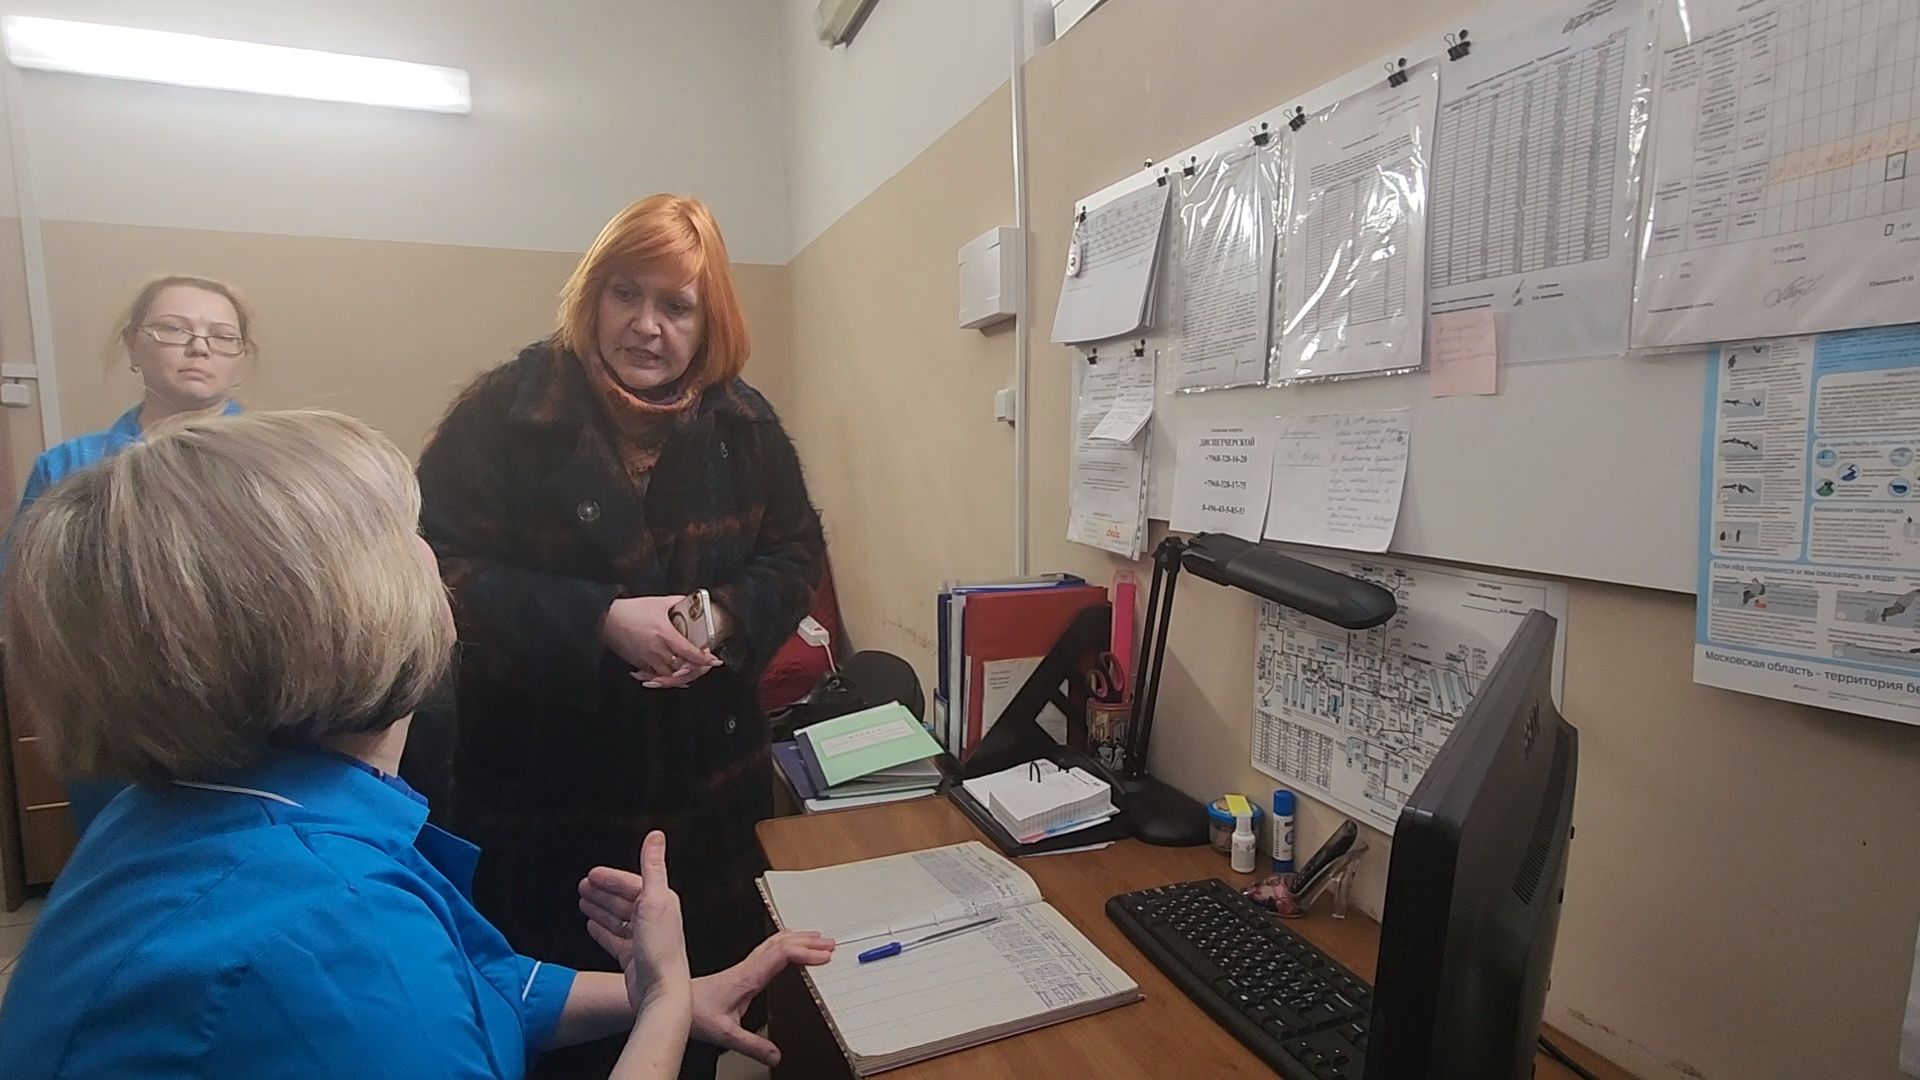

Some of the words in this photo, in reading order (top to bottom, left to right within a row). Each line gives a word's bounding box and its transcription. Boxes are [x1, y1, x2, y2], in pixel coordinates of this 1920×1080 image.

[1705, 651, 1766, 669] Московская
[1767, 661, 1814, 677] область
[1824, 671, 1903, 691] территория
